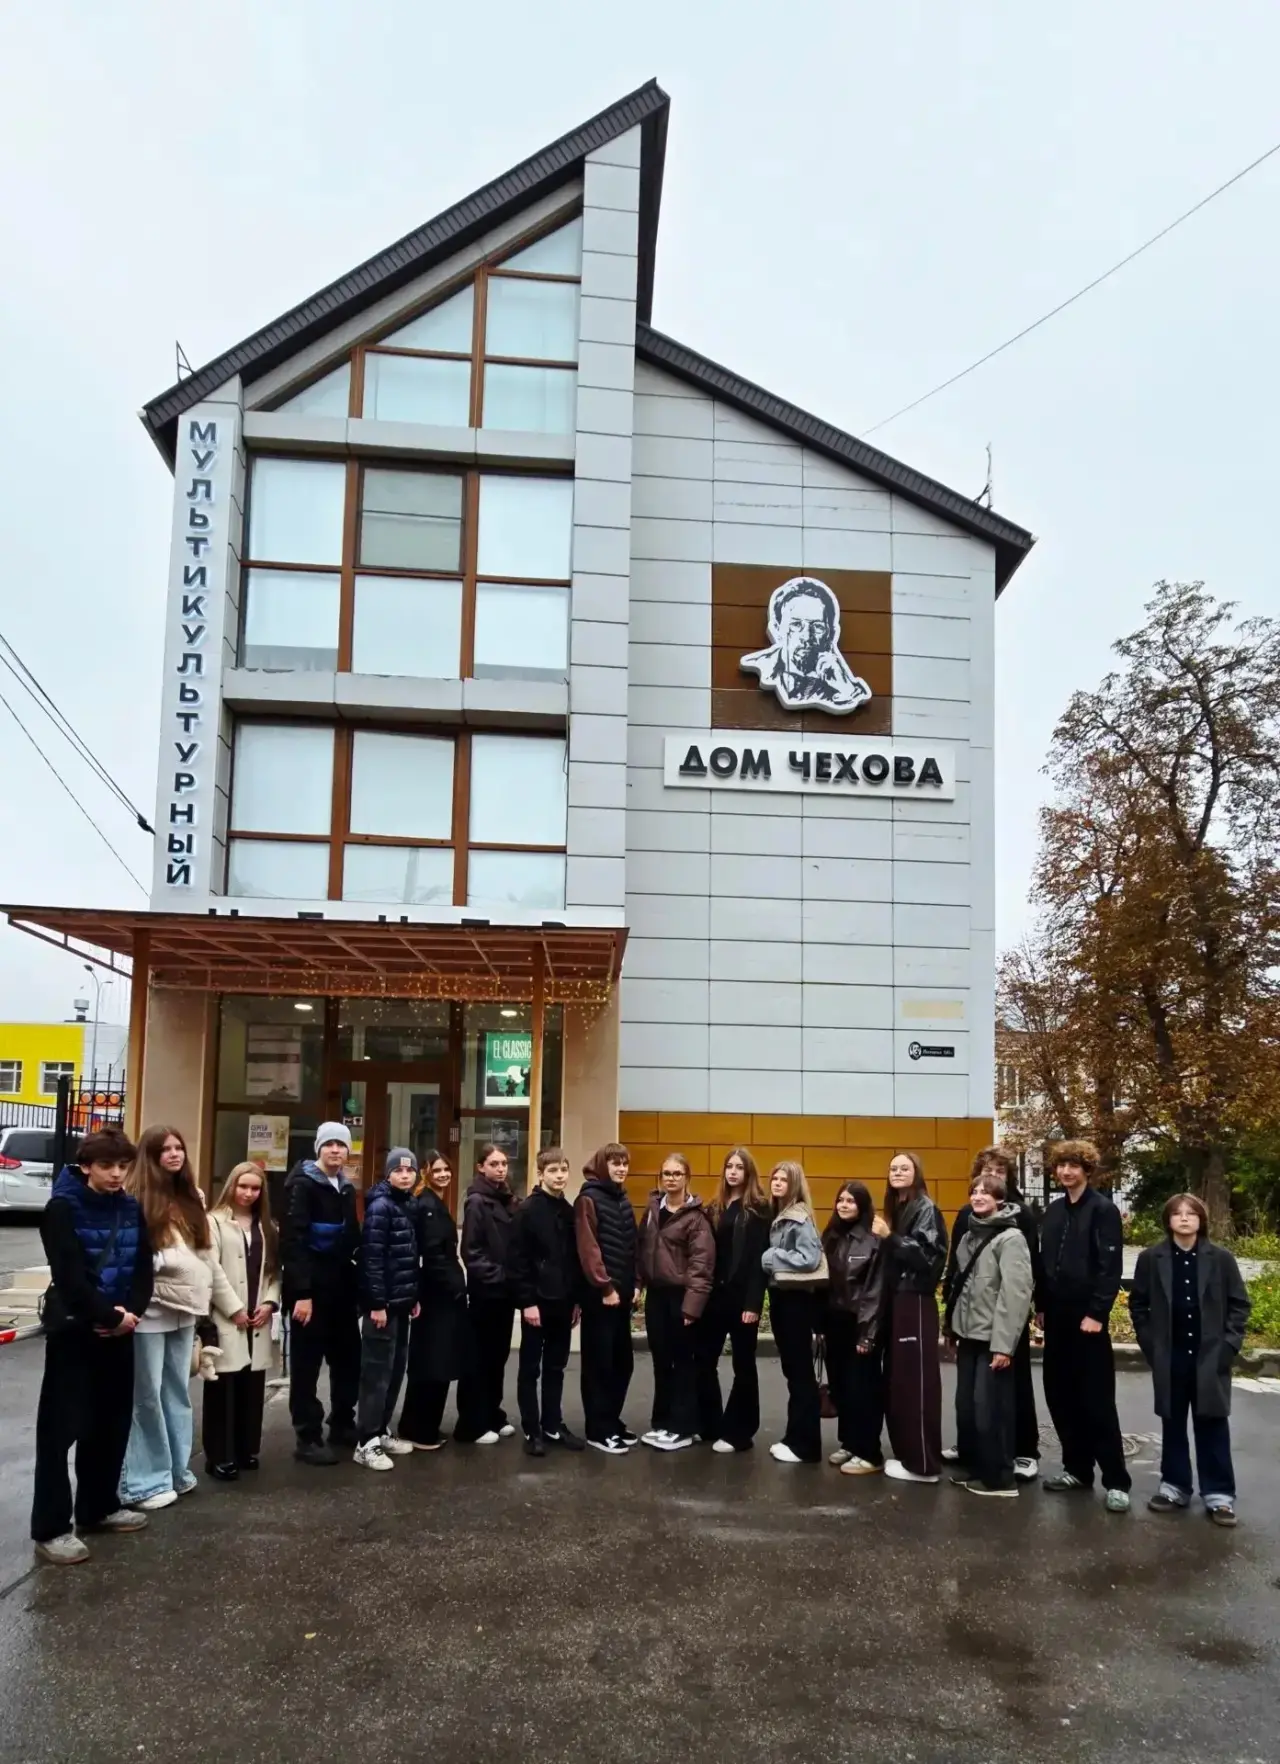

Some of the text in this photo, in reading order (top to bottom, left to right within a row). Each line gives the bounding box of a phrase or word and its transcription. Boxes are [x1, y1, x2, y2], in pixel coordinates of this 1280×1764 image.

[166, 420, 217, 885] МУЛЬТИКУЛЬТУРНЫЙ
[679, 745, 944, 787] ДОМ ЧЕХОВА
[493, 1040, 501, 1059] EL
